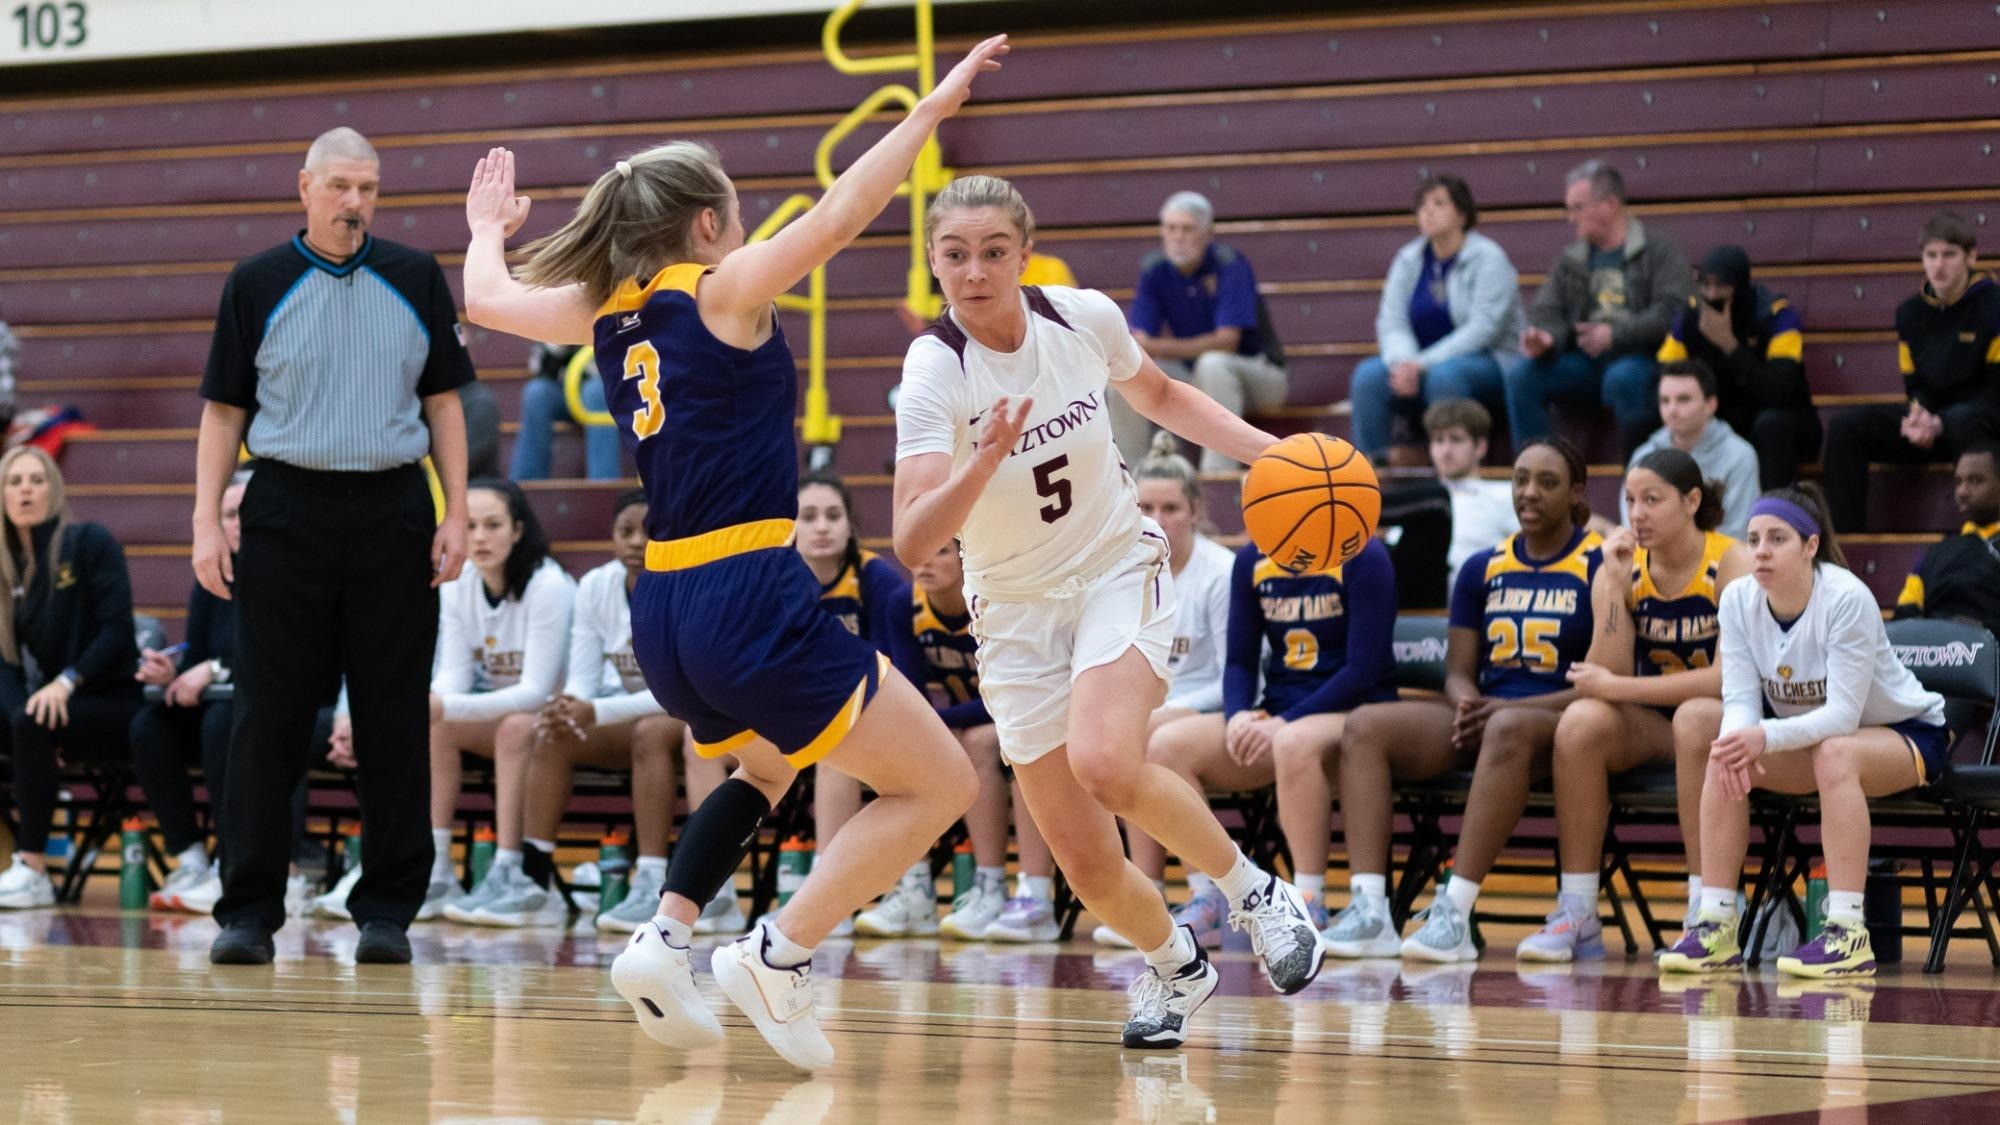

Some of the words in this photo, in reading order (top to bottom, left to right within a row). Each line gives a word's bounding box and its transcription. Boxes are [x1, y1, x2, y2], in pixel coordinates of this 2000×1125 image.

[13, 2, 87, 47] 103
[622, 339, 666, 441] 3
[972, 390, 1099, 457] ZTOWN
[1032, 453, 1072, 524] 5
[1532, 588, 1577, 615] RAMS
[1283, 628, 1319, 671] 0
[1487, 617, 1561, 672] 25
[1783, 679, 1826, 697] CHEST
